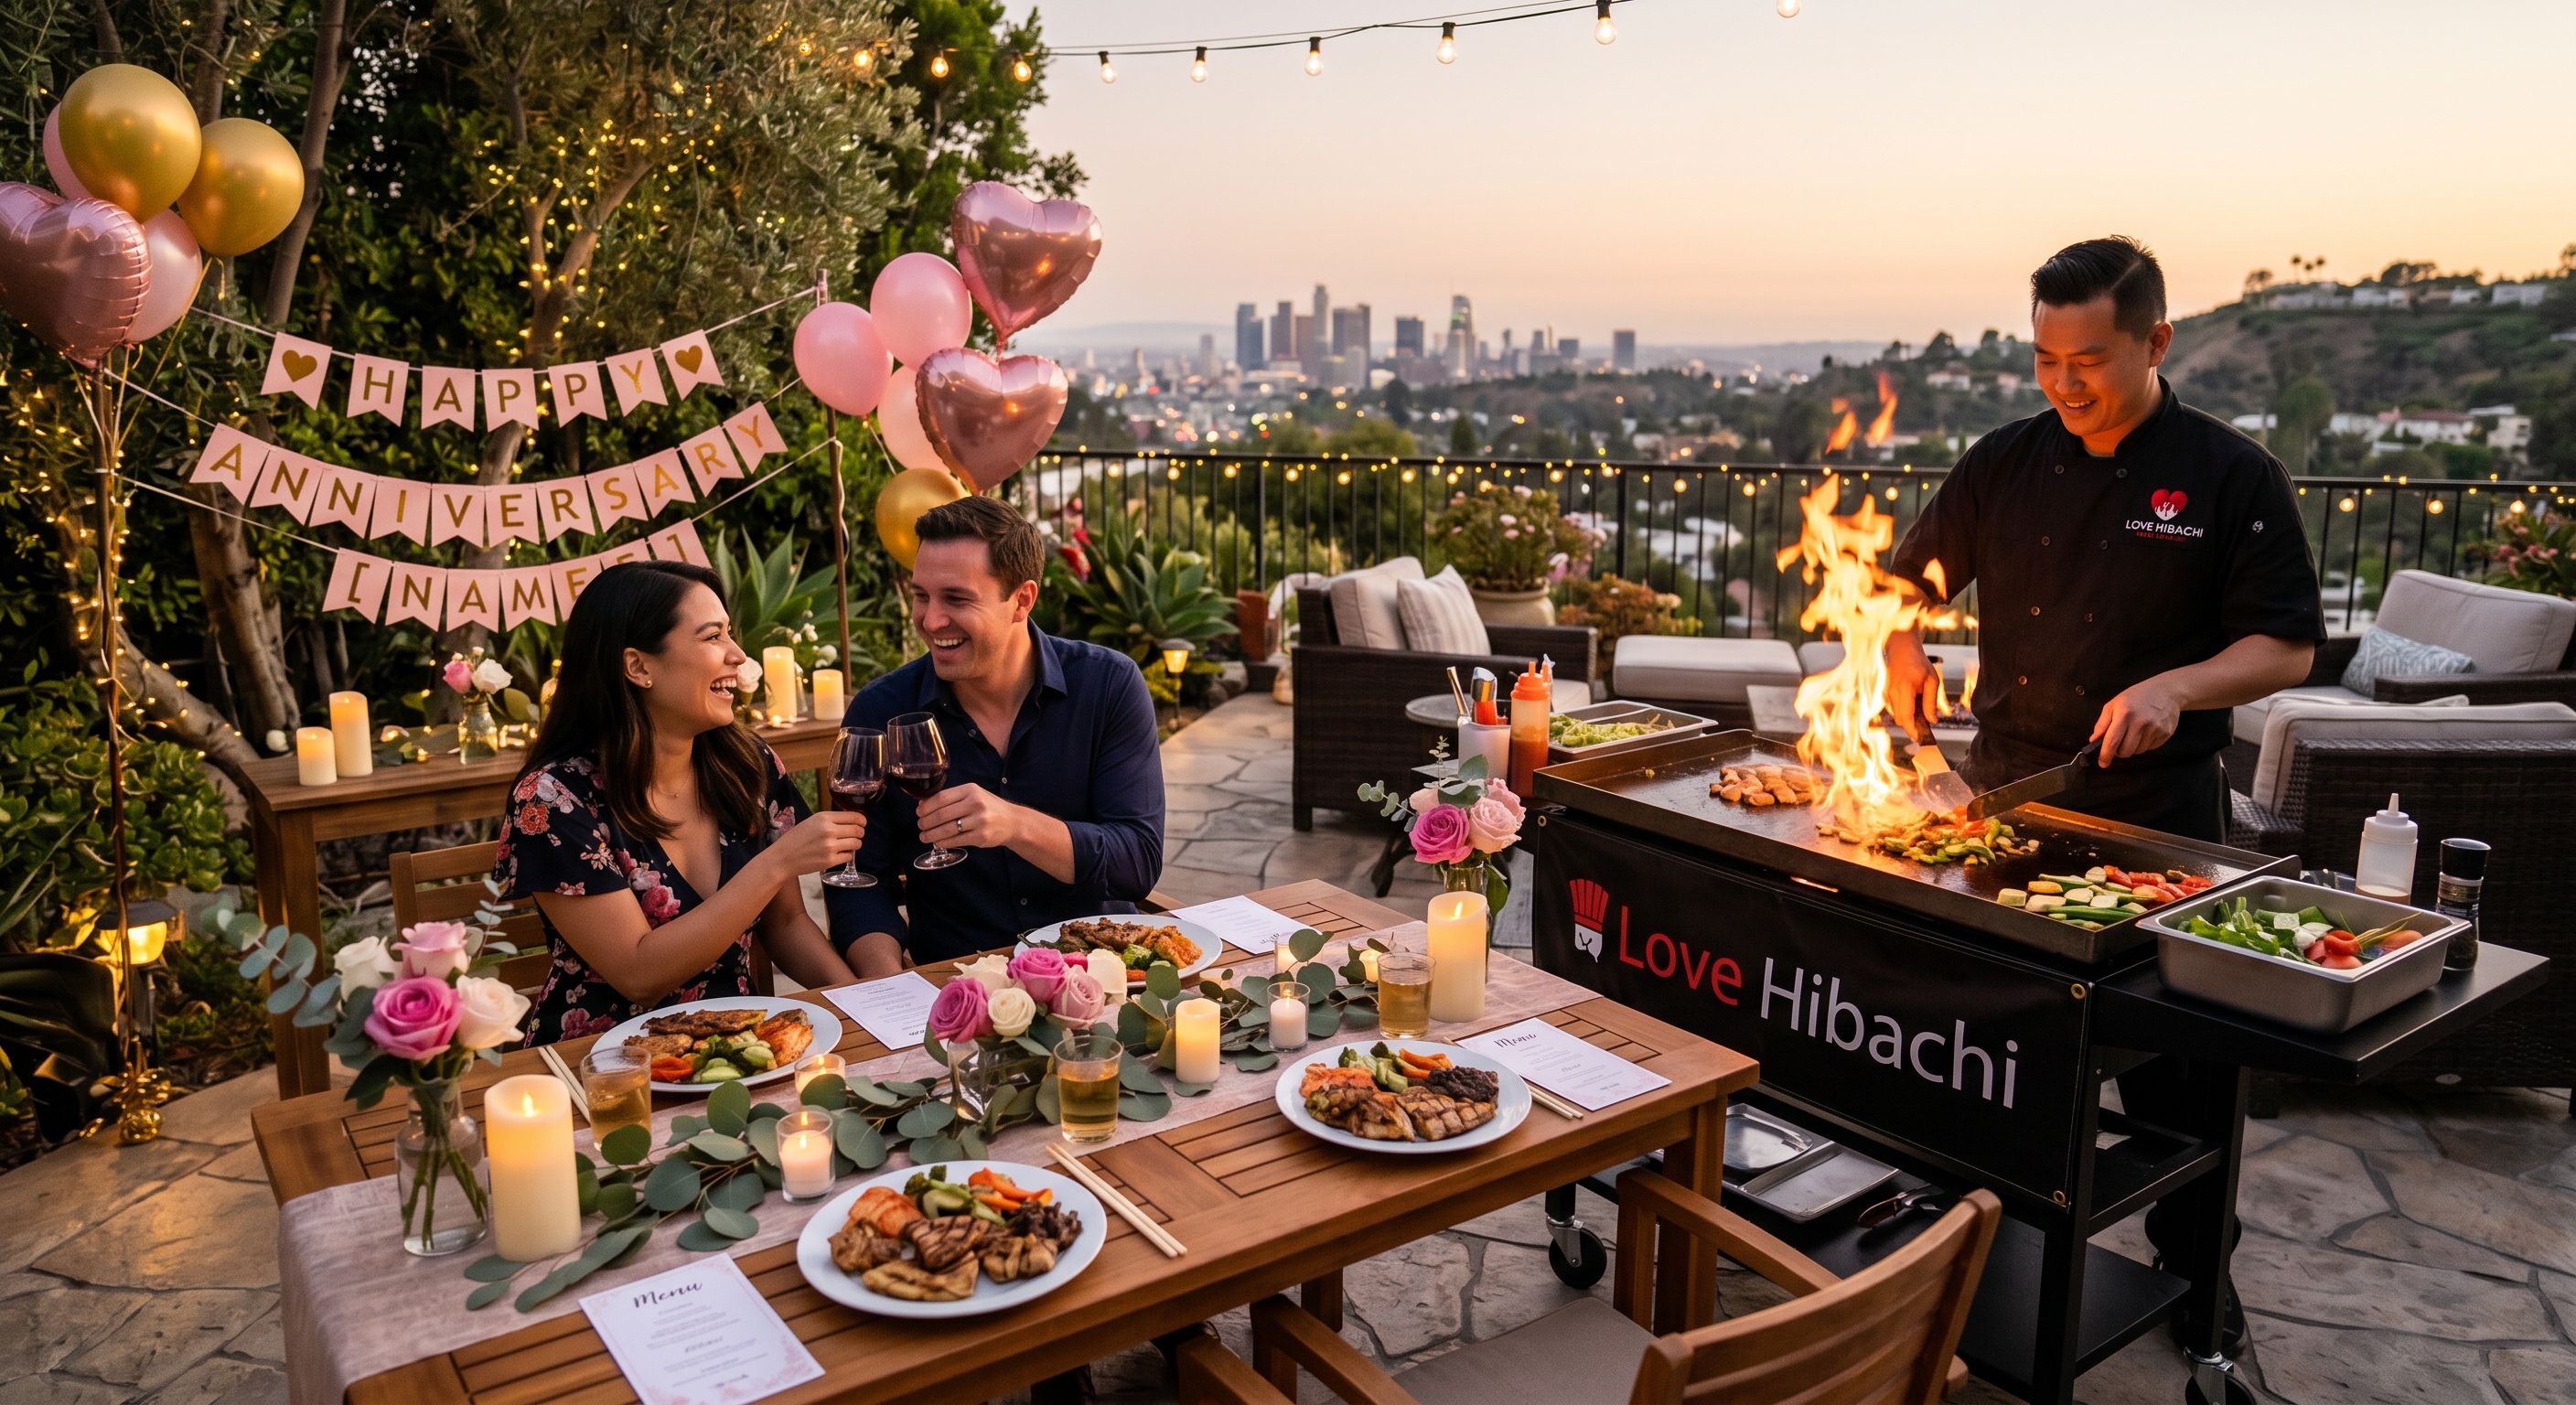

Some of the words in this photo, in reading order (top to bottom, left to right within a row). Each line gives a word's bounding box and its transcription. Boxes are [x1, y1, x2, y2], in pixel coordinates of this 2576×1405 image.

[363, 359, 644, 413] HAPPY
[209, 414, 764, 529] ANNIVERSARY
[2125, 520, 2154, 531] LOVE
[2155, 522, 2204, 538] HIBACHI
[1618, 905, 1743, 1006] Love
[1760, 956, 2019, 1110] Hibachi
[633, 1281, 703, 1308] Menu
